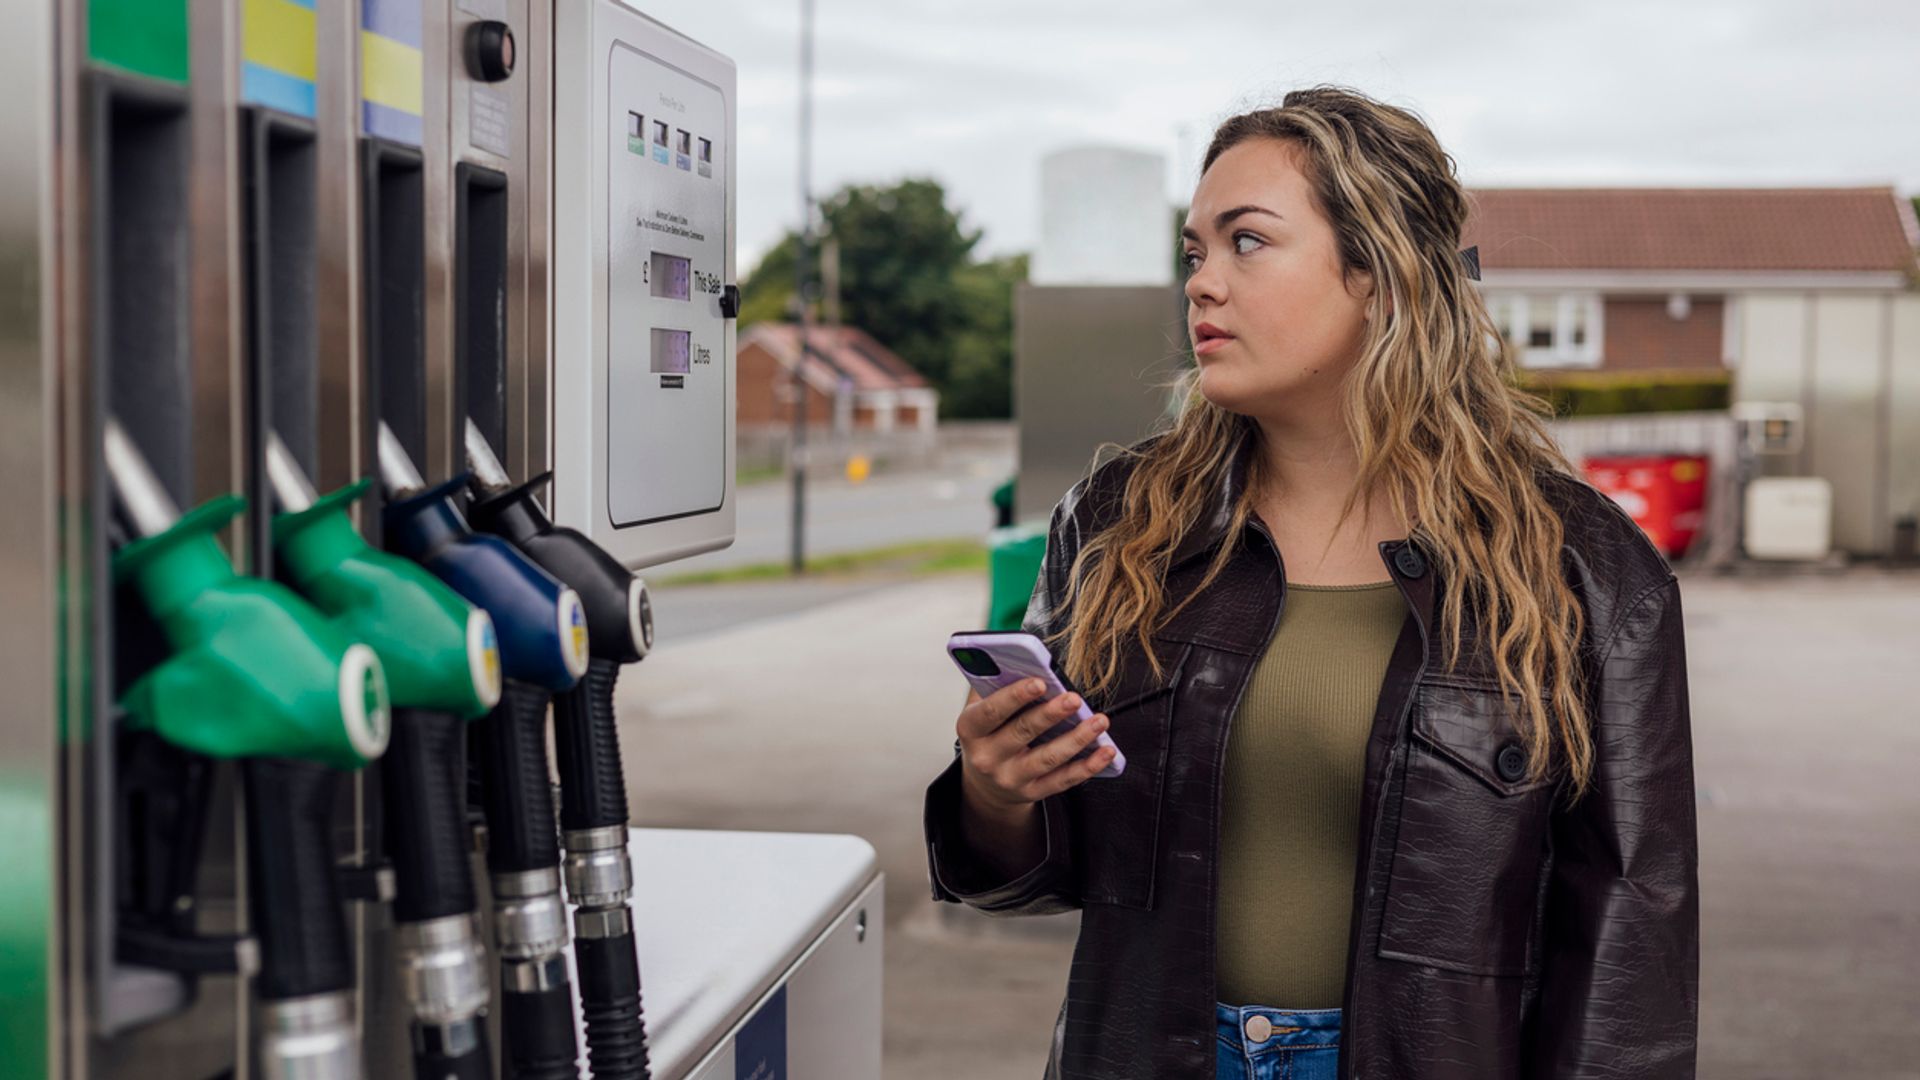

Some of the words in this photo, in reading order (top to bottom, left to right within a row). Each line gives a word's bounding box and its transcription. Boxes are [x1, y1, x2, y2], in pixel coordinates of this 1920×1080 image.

[694, 269, 707, 292] This
[708, 272, 721, 294] Sale
[693, 343, 710, 364] Litres
